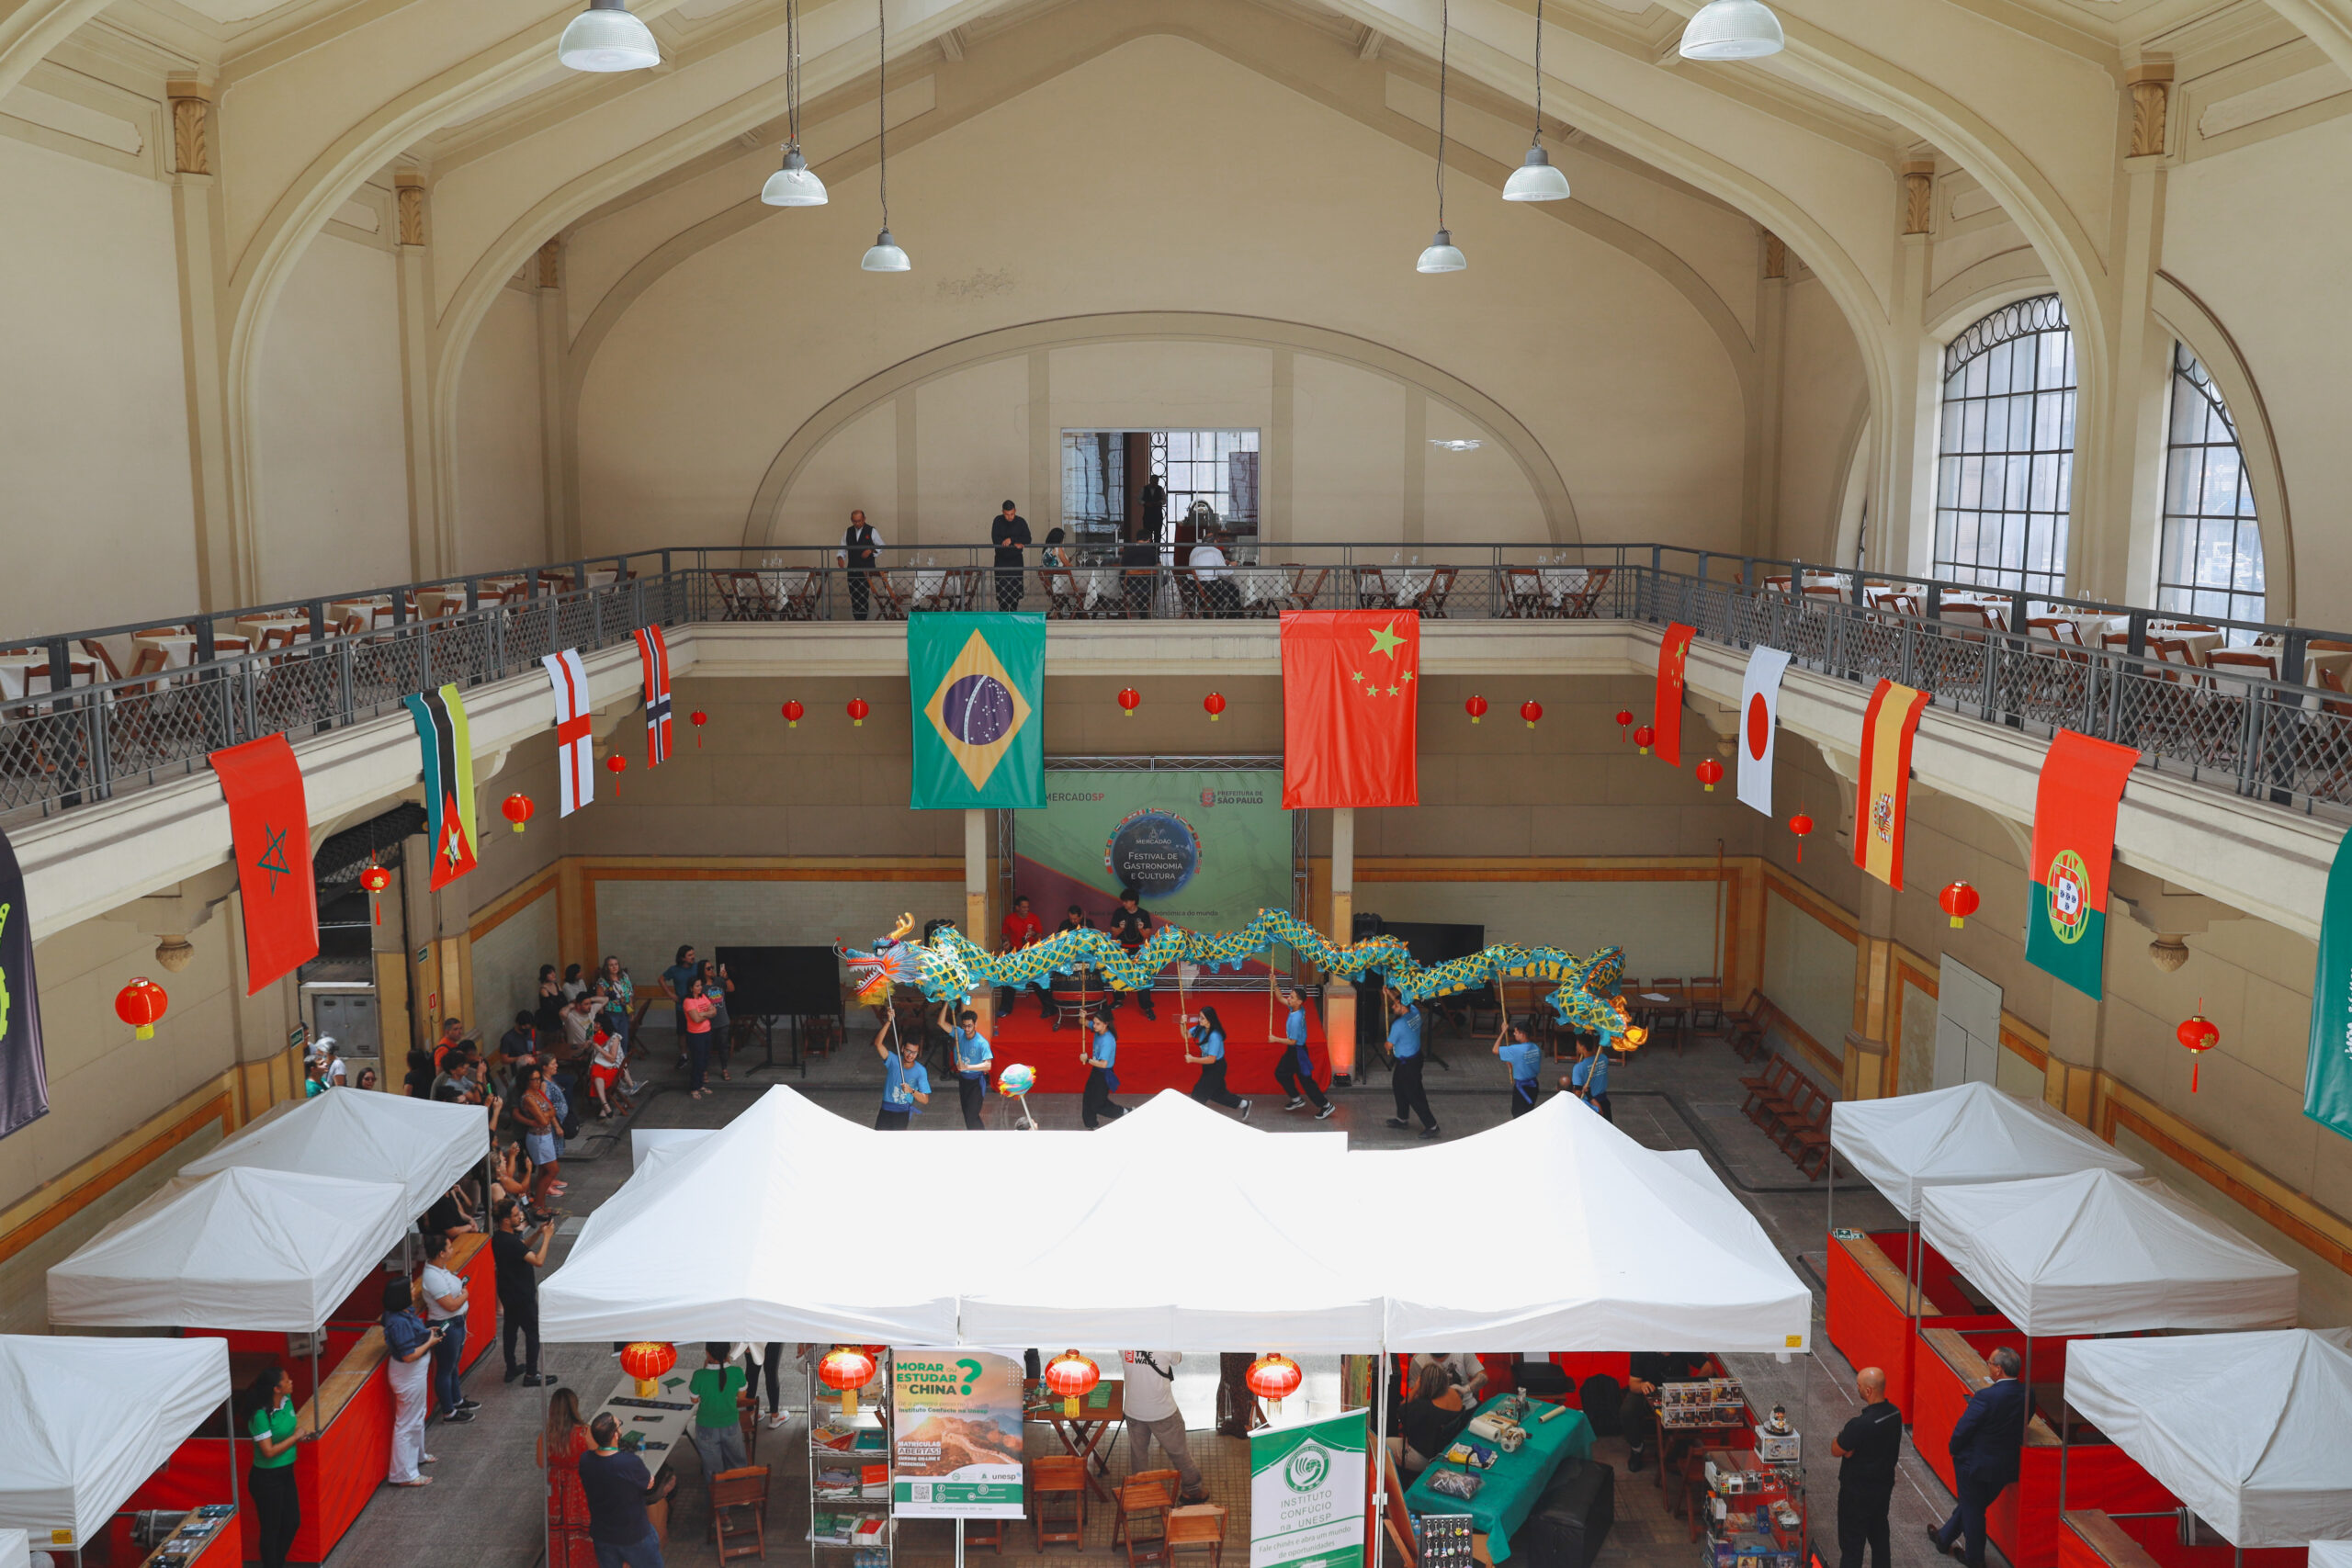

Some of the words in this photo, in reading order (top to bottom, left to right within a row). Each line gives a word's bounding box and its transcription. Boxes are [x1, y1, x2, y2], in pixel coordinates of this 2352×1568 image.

[1217, 796, 1235, 805] SÃO
[896, 1362, 944, 1372] MORAR
[896, 1373, 957, 1382] ESTUDAR
[909, 1383, 957, 1395] CHINA
[991, 1472, 1016, 1483] unesp
[1280, 1490, 1332, 1508] INSTITUTO
[1280, 1501, 1332, 1520] CONFÚCIO
[1280, 1524, 1292, 1532] na
[1297, 1512, 1332, 1529] UNESP
[1259, 1544, 1272, 1553] Fale
[1272, 1540, 1295, 1551] chinês
[1301, 1535, 1316, 1544] abra
[1328, 1525, 1351, 1537] mundo
[1278, 1551, 1287, 1559] de
[1287, 1540, 1335, 1558] oportunidades
